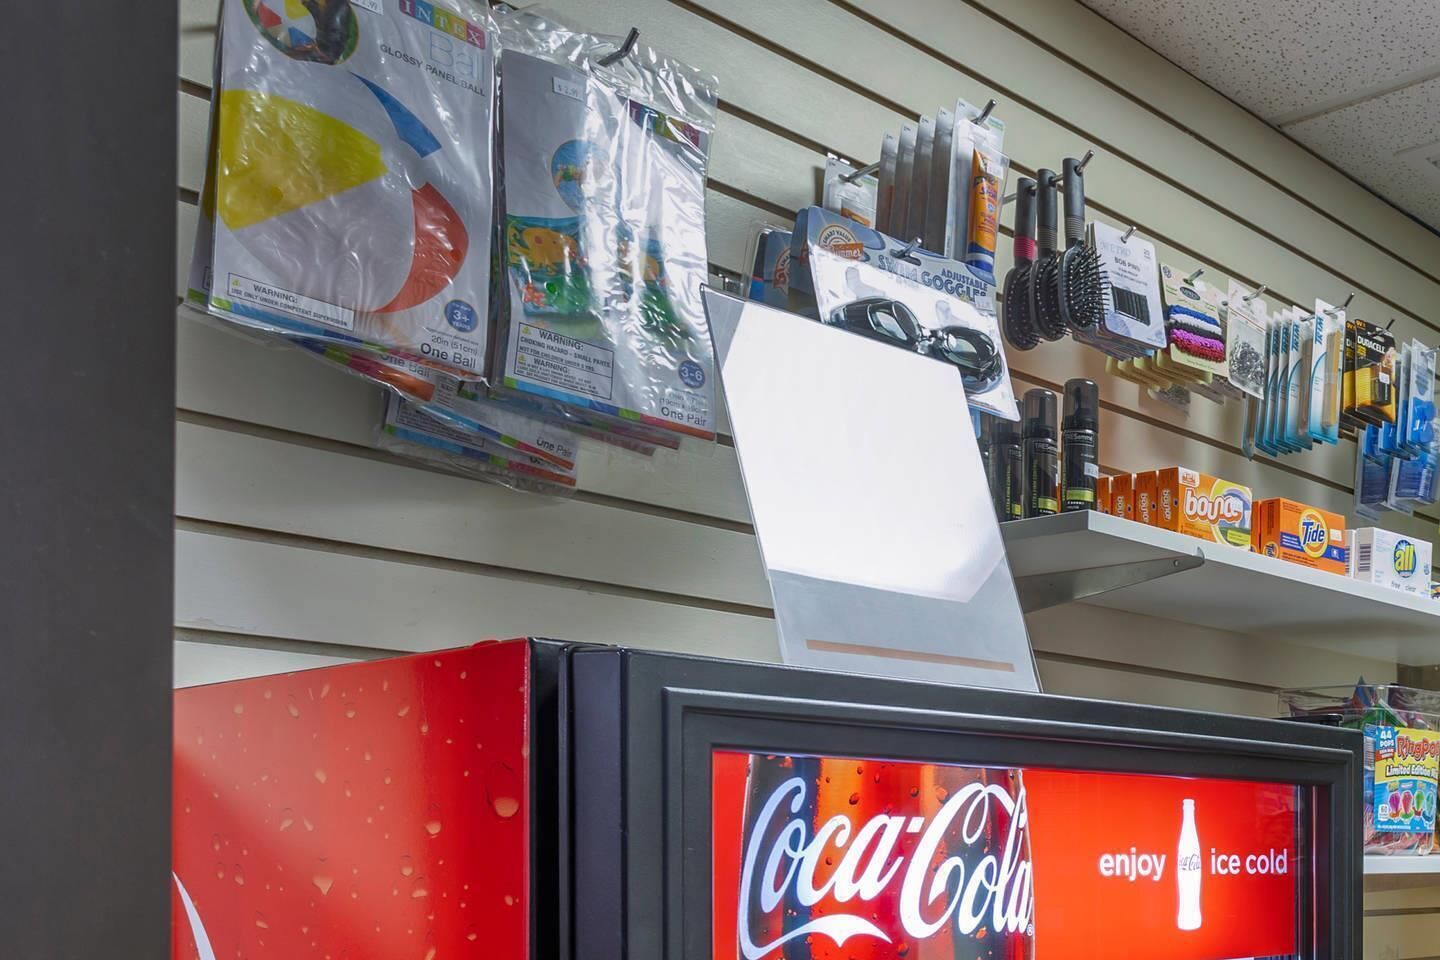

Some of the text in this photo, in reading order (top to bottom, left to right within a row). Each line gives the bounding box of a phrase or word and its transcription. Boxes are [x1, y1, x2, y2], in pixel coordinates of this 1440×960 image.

[402, 0, 483, 47] INTEX
[380, 44, 422, 68] GLOSSY
[425, 65, 459, 85] PANEL
[941, 267, 988, 292] ADJUSTABLE
[452, 310, 470, 324] 3+
[1314, 315, 1324, 345] TRIM
[539, 329, 584, 351] WARNING:
[1291, 323, 1300, 352] TRIM
[1357, 336, 1386, 353] DURACELL
[420, 342, 476, 370] One Ball
[533, 358, 570, 374] WARNING:
[681, 367, 703, 381] 3-6
[661, 406, 706, 427] One Pair
[1183, 487, 1244, 524] bounce
[1302, 520, 1325, 546] Tide
[1395, 543, 1415, 571] all
[1379, 739, 1394, 748] POPS
[1380, 730, 1392, 739] 44
[1386, 763, 1411, 778] Limited
[1412, 763, 1431, 778] Edition
[739, 775, 1036, 960] Coca-Cola
[1099, 848, 1166, 883] enjoy
[1210, 848, 1288, 875] ice cold
